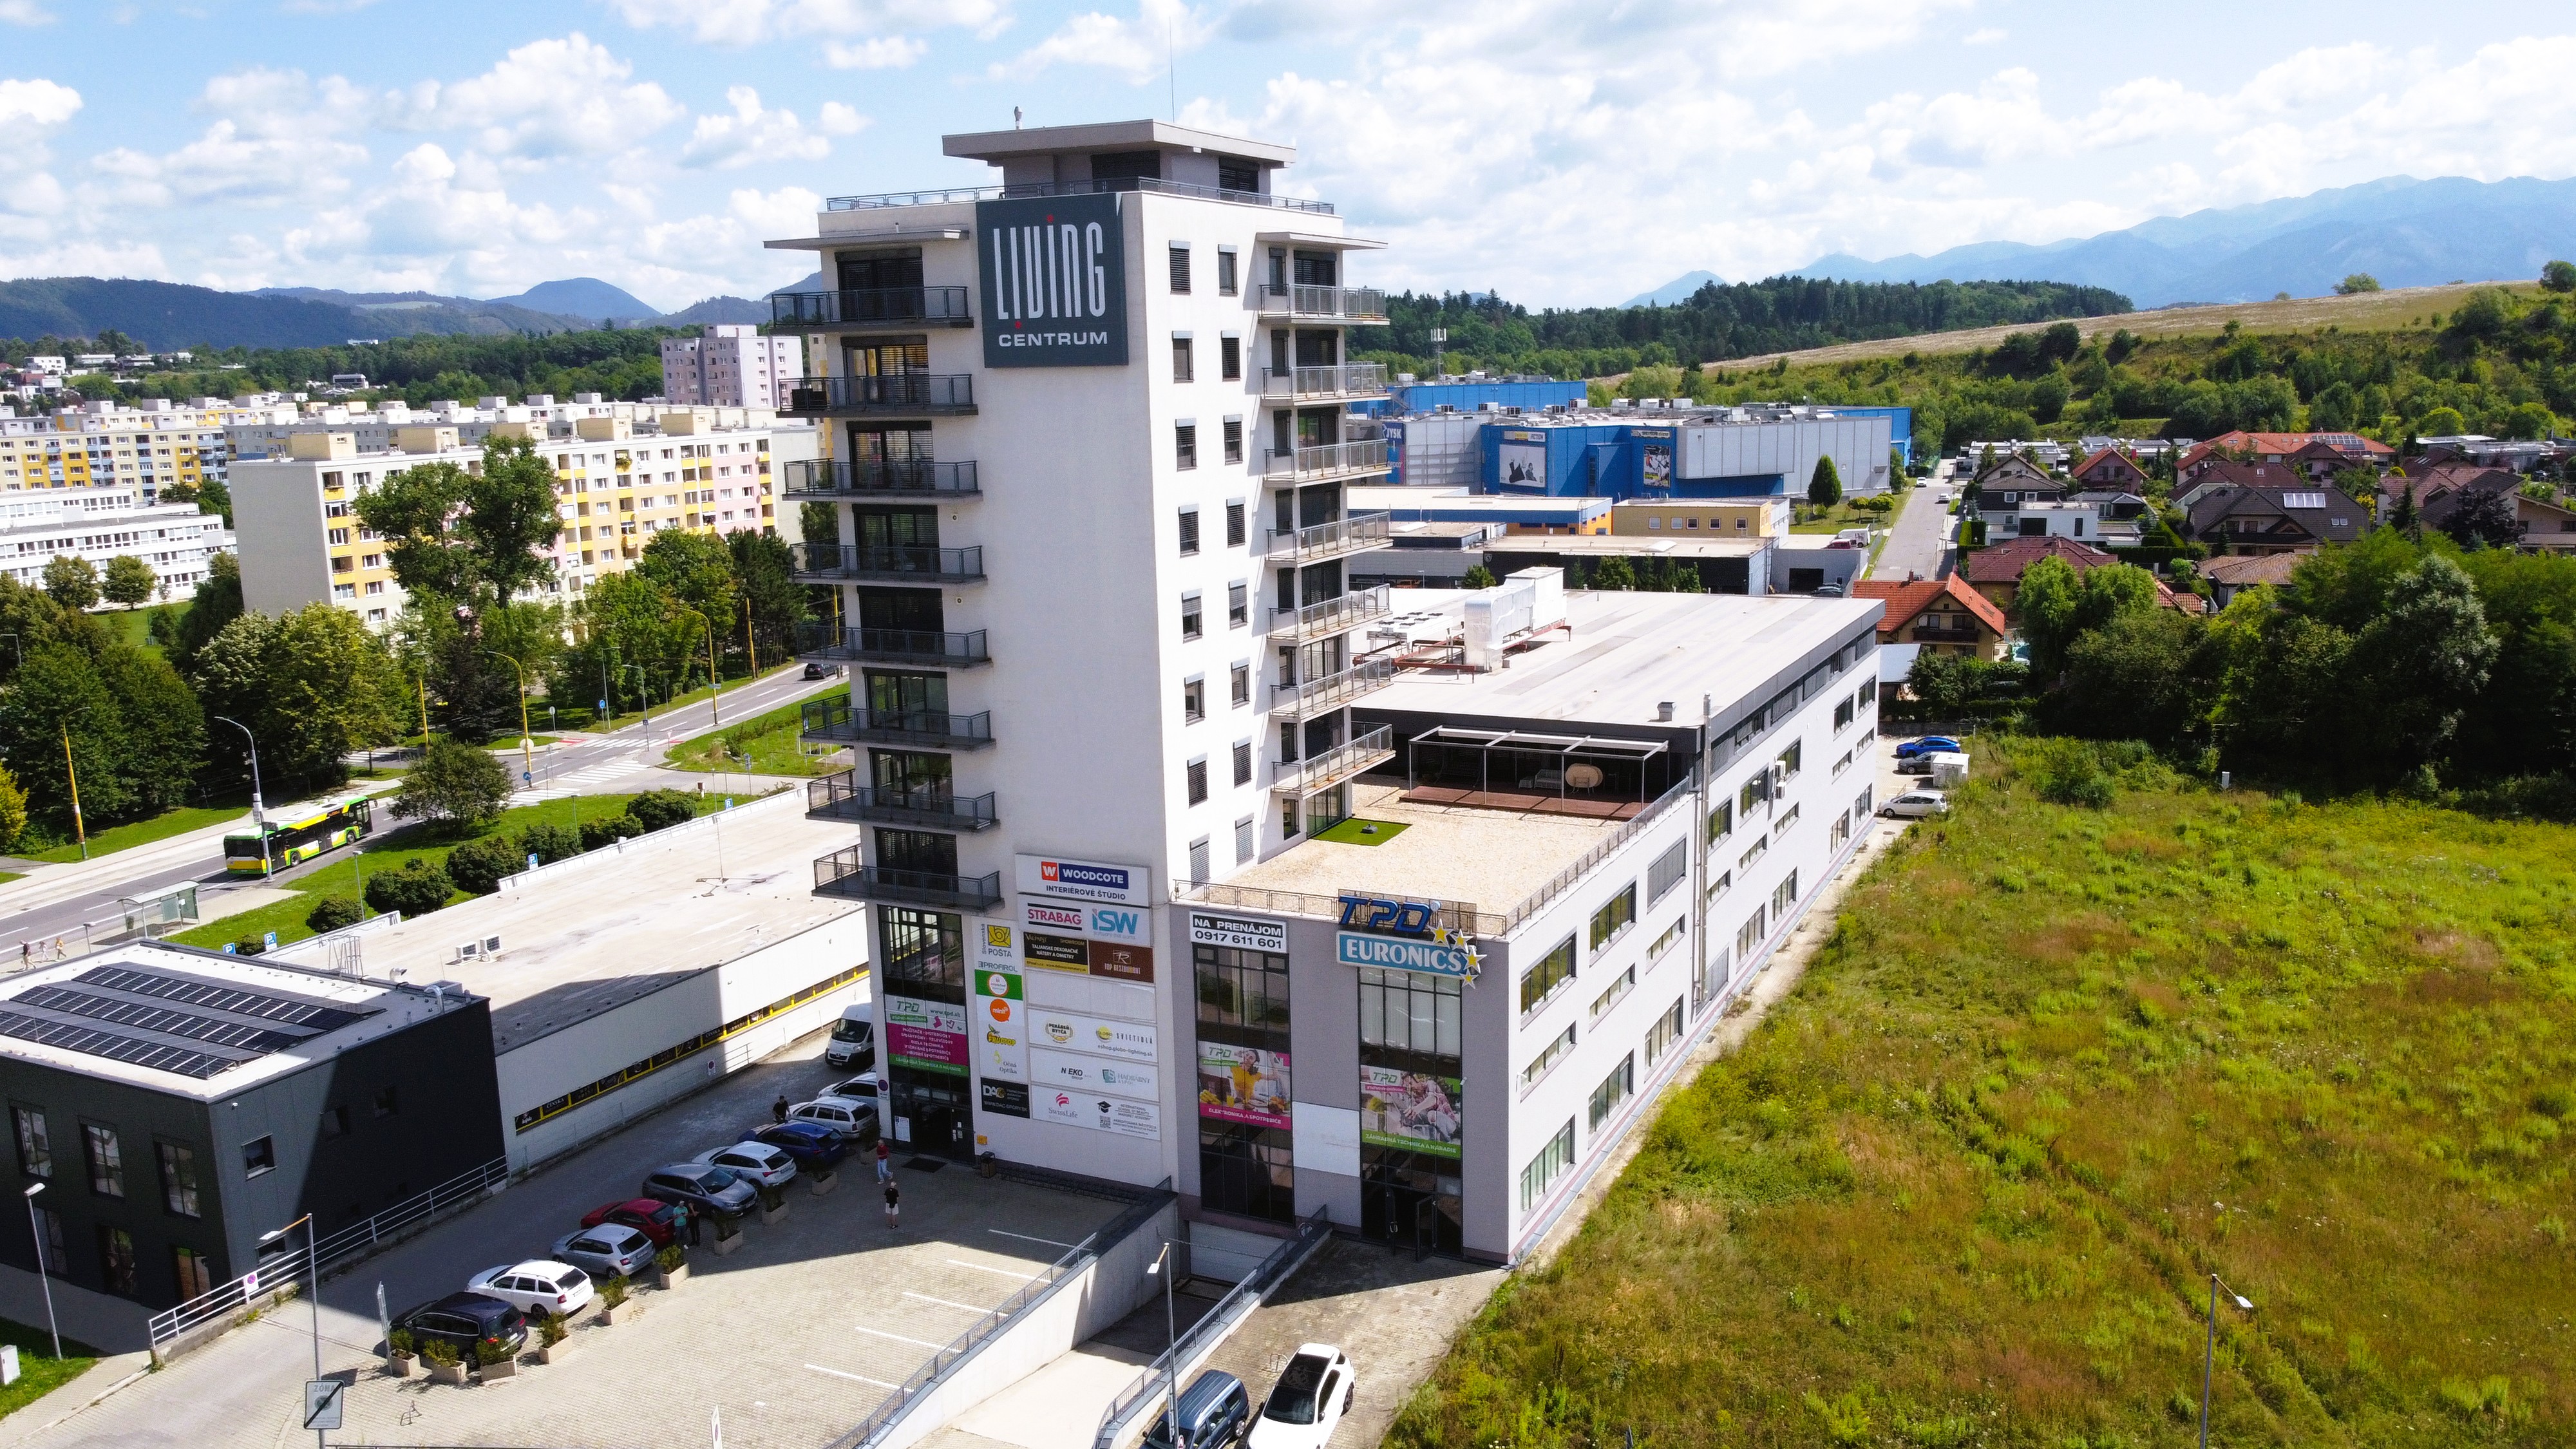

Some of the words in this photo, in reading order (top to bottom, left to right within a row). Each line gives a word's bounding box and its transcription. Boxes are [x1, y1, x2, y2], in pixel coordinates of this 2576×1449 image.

[998, 331, 1108, 347] CENTRUM
[1387, 428, 1402, 439] JYSK
[1062, 868, 1124, 884] WOODCOTE
[1046, 885, 1095, 896] INTERIÉROVÉ
[1097, 889, 1126, 900] ŠTÚDIO
[1028, 909, 1082, 925] STRABAG
[1338, 895, 1432, 933] TPD
[1194, 918, 1211, 928] NA
[1217, 920, 1282, 936] PRENÁJOM
[266, 934, 272, 945] P
[1195, 930, 1227, 942] 0917
[1232, 934, 1253, 945] 611
[1258, 938, 1282, 949] 601
[988, 948, 1012, 958] POŠTA
[1346, 938, 1462, 972] EURONICS
[896, 1000, 920, 1012] TPD
[1373, 1072, 1398, 1083] TPD
